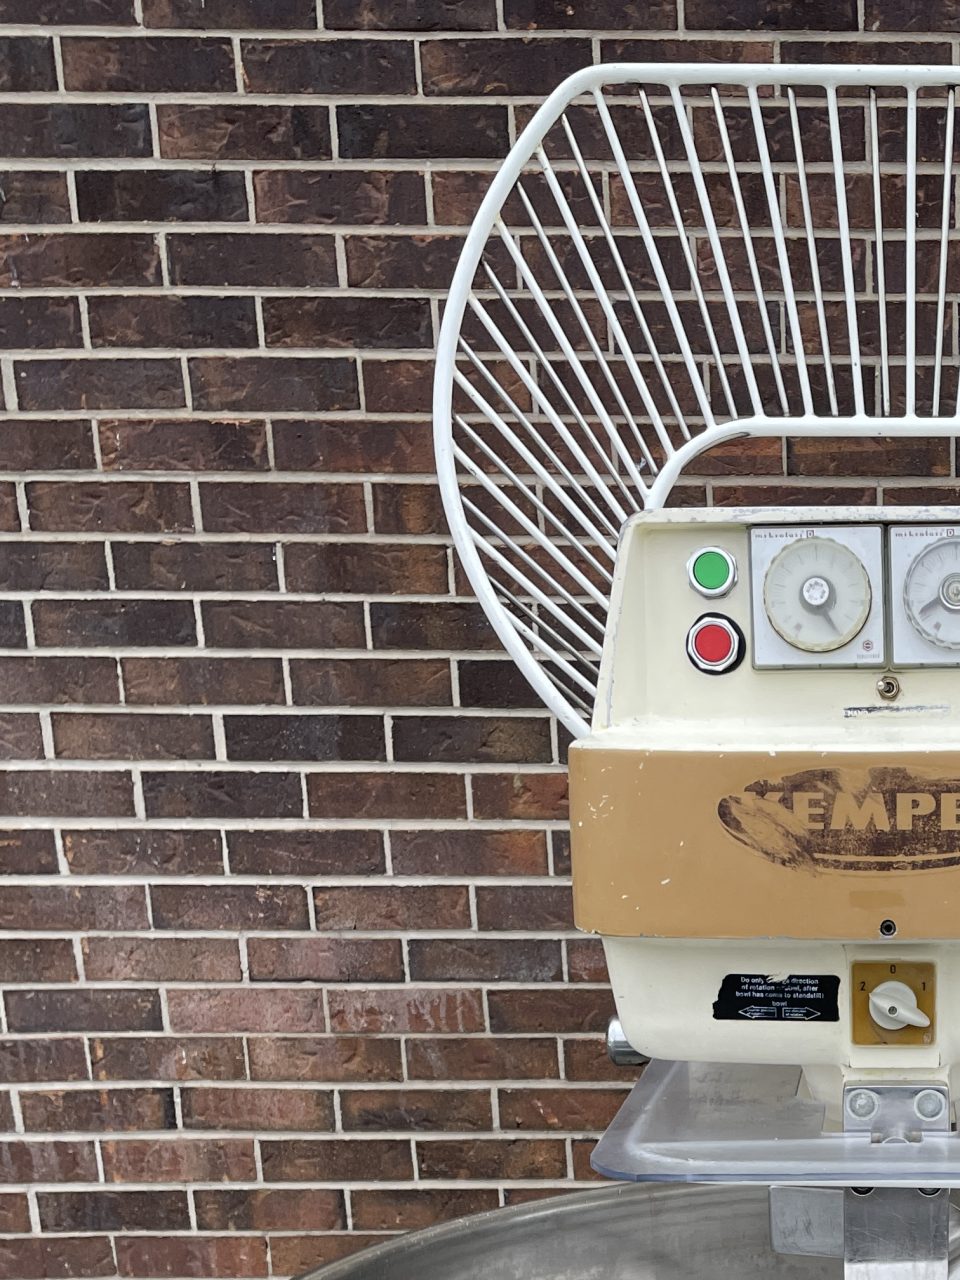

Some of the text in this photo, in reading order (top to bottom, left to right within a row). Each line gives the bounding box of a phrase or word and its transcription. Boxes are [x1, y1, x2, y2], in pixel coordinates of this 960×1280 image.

[889, 964, 897, 974] 0
[740, 976, 750, 984] Do
[751, 976, 765, 985] only
[859, 981, 866, 992] 2
[921, 981, 927, 992] 1
